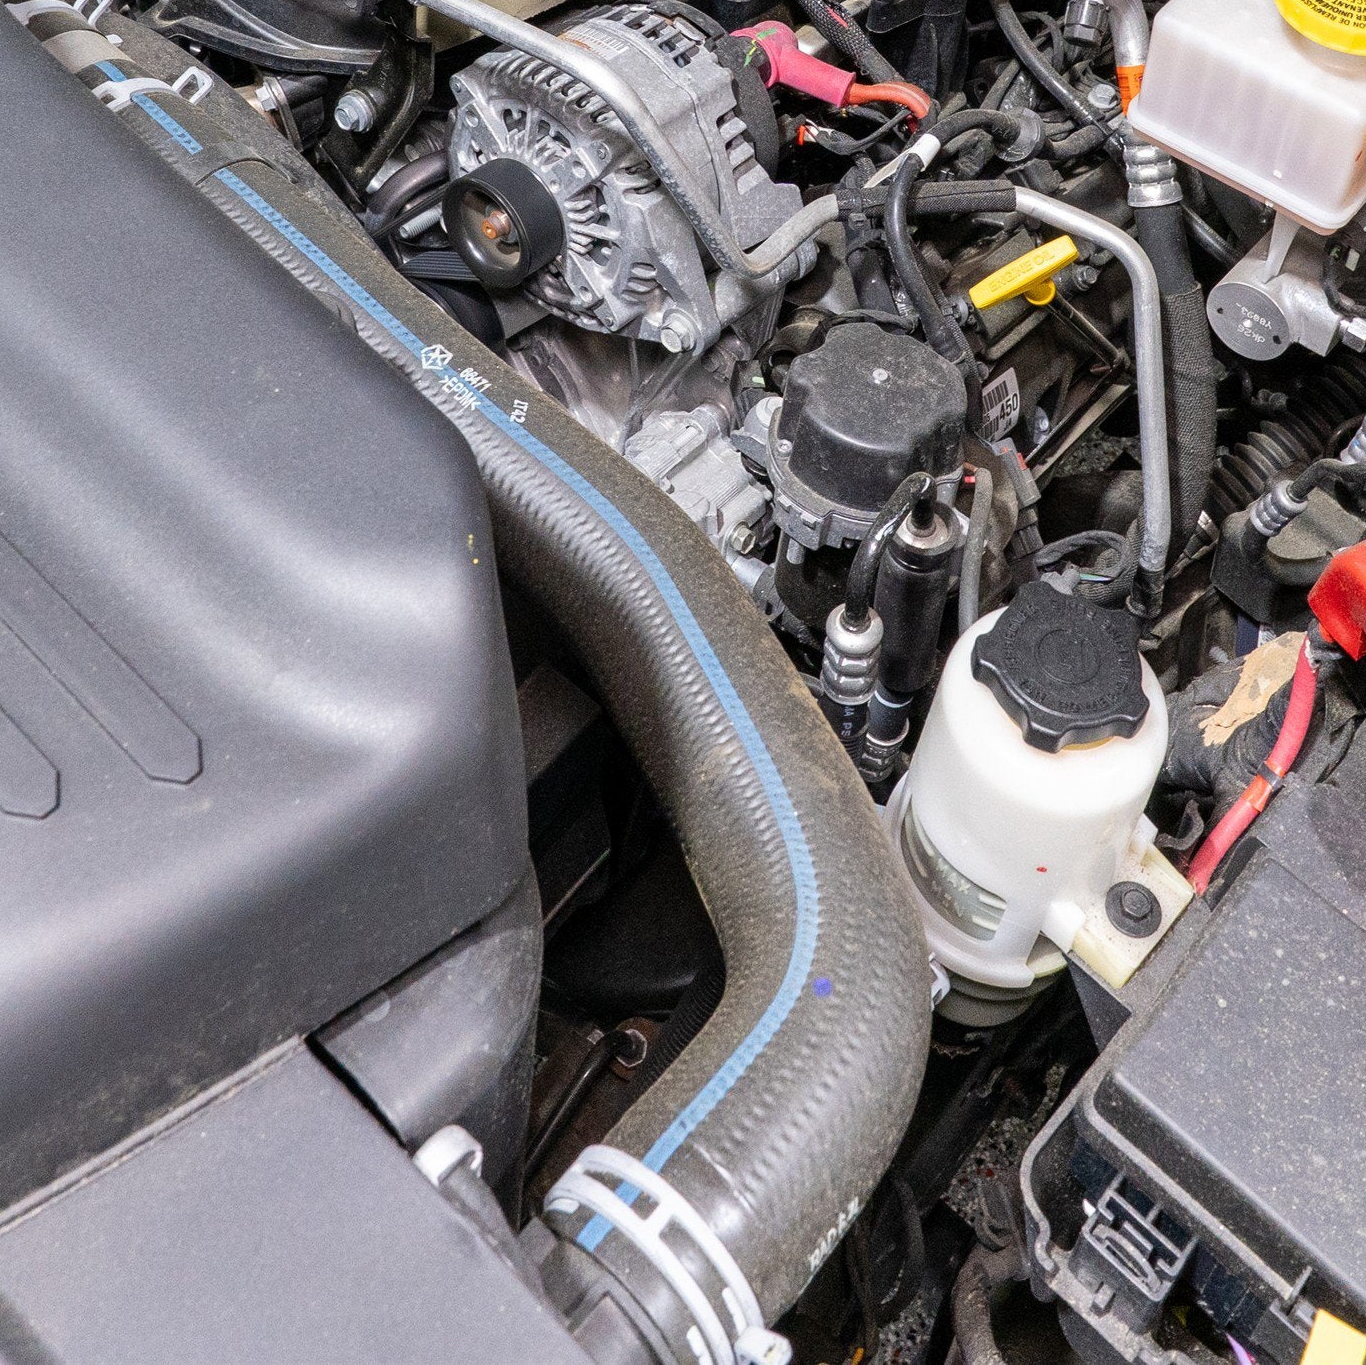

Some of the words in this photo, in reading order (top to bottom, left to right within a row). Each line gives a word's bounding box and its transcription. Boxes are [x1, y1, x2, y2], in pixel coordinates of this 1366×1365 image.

[987, 262, 1034, 292] ENGINE
[1032, 249, 1056, 267] OIL
[1000, 392, 1020, 421] 450
